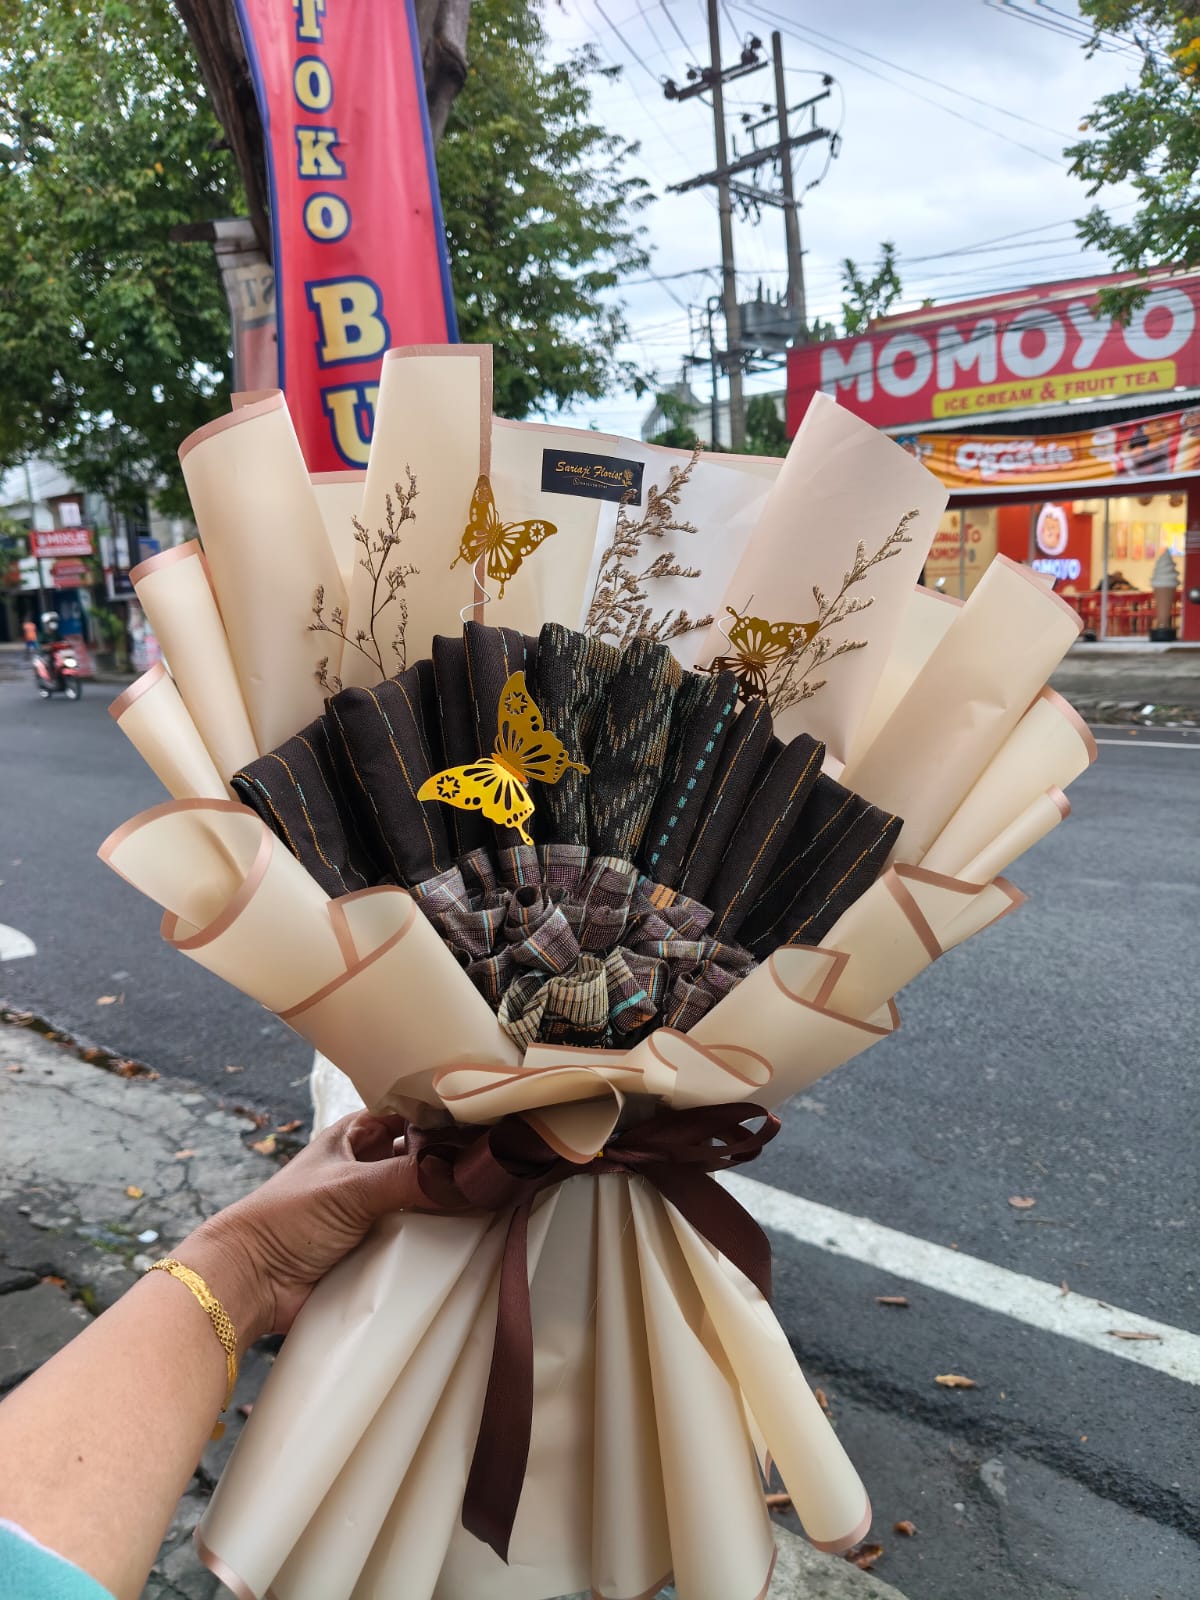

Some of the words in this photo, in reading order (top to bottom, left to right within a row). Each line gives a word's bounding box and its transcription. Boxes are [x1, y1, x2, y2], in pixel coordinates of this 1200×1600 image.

[293, 0, 351, 242] TOKO
[820, 286, 1196, 402] MOMOYO
[944, 399, 969, 412] ICE
[975, 387, 1033, 407] CREAM
[1039, 382, 1056, 400] &
[1063, 376, 1117, 395] FRUIT
[1125, 371, 1159, 387] TEA
[555, 461, 591, 478] Sariaji
[593, 465, 623, 480] Florist
